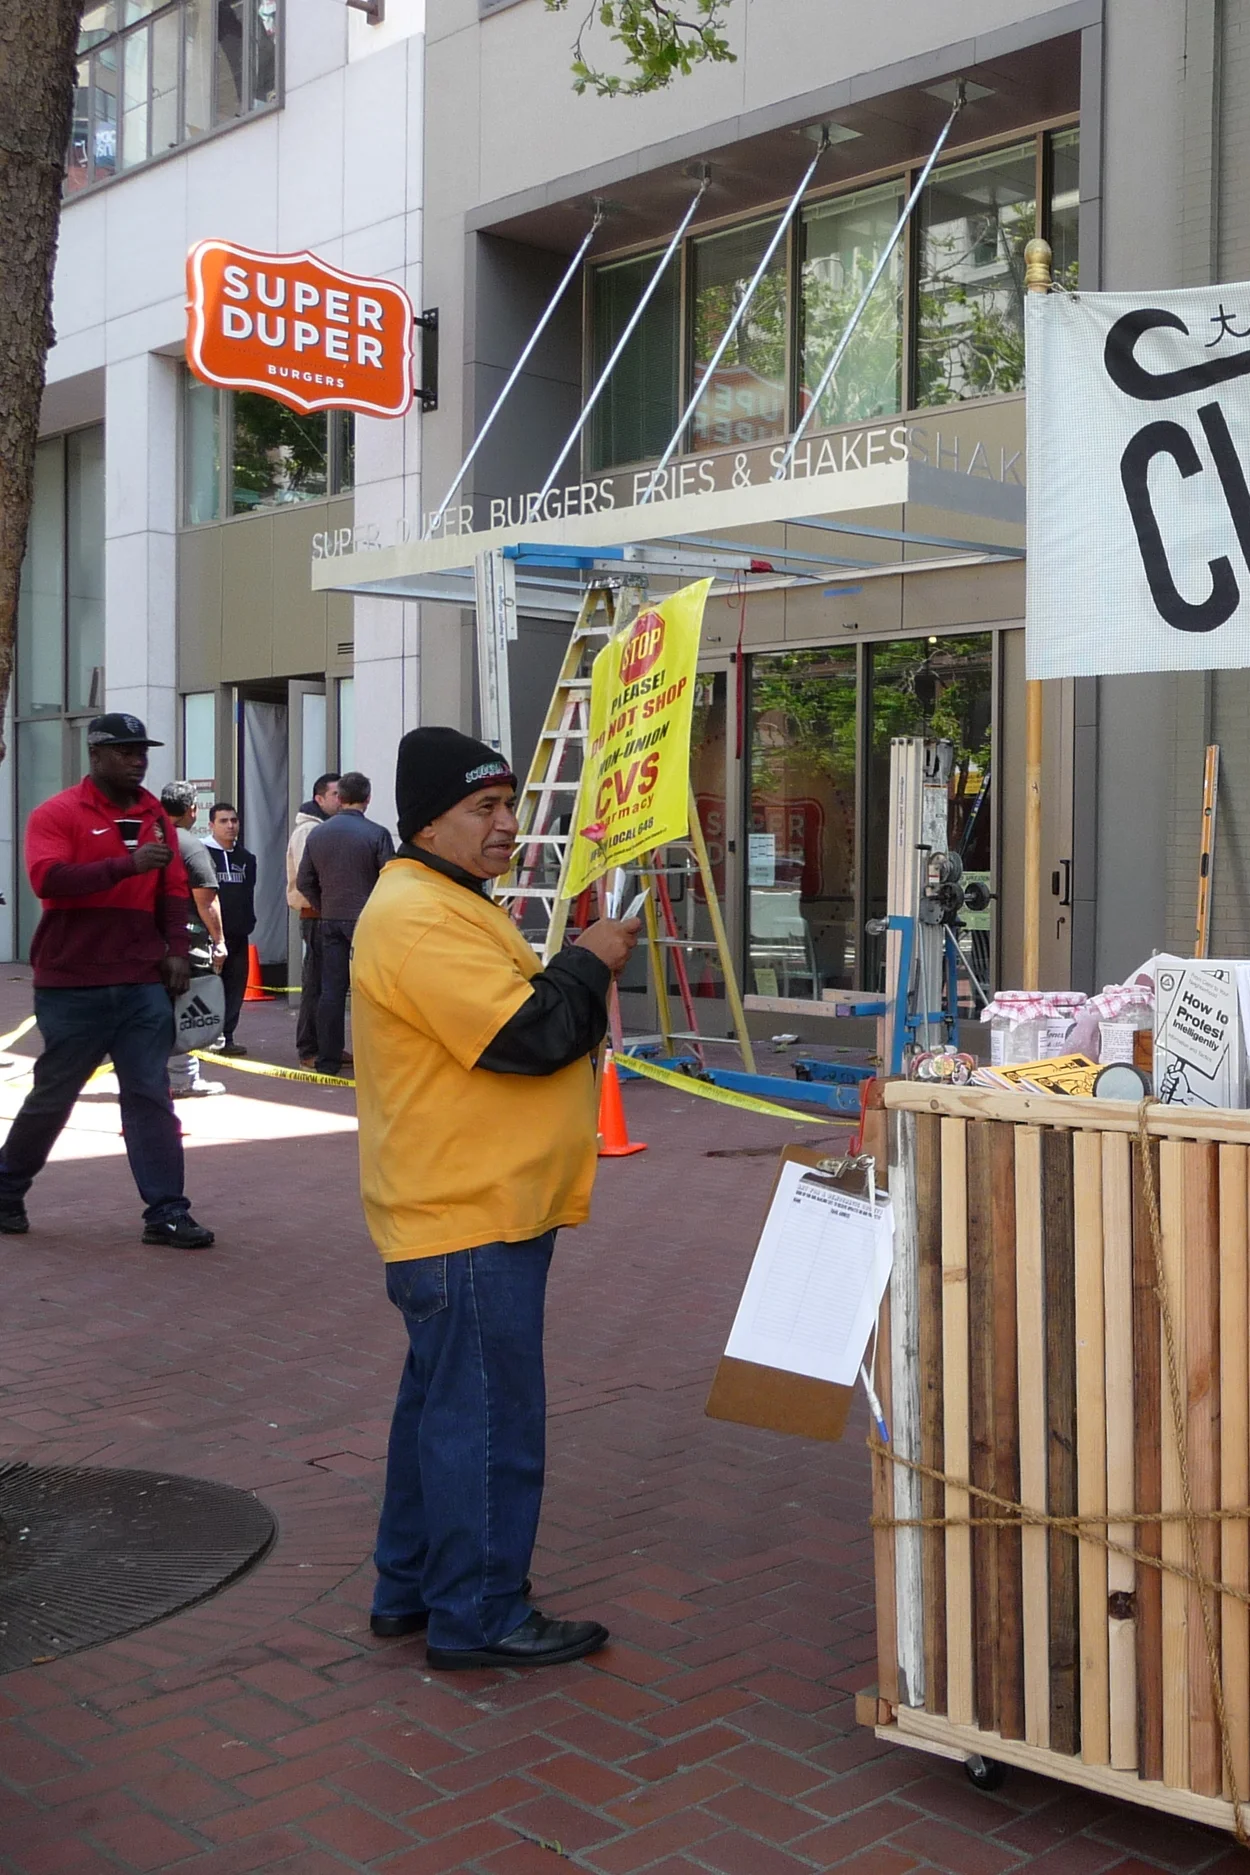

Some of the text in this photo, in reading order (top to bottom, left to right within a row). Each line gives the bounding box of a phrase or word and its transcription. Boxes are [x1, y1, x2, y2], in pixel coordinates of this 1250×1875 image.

[223, 265, 383, 331] SUPER
[222, 304, 383, 369] DUPER
[267, 364, 345, 389] BURGERS
[490, 478, 615, 527] BURGERS
[632, 459, 715, 506] FRIES
[731, 452, 751, 489] &
[769, 425, 910, 482] SHAKES
[621, 627, 661, 671] STOP
[611, 669, 666, 716] PLEASE!
[591, 676, 688, 760] DO NOT SHOP
[597, 720, 671, 780] NON-UNION
[595, 751, 660, 820] CVS
[600, 793, 655, 827] armacy
[608, 826, 637, 849] LOCAL
[637, 815, 654, 836] 648
[179, 1015, 220, 1031] adidas
[1176, 1005, 1224, 1041] Protest
[1182, 990, 1230, 1025] How to
[1172, 1018, 1219, 1052] Intelligently
[289, 1071, 318, 1083] CAUTION
